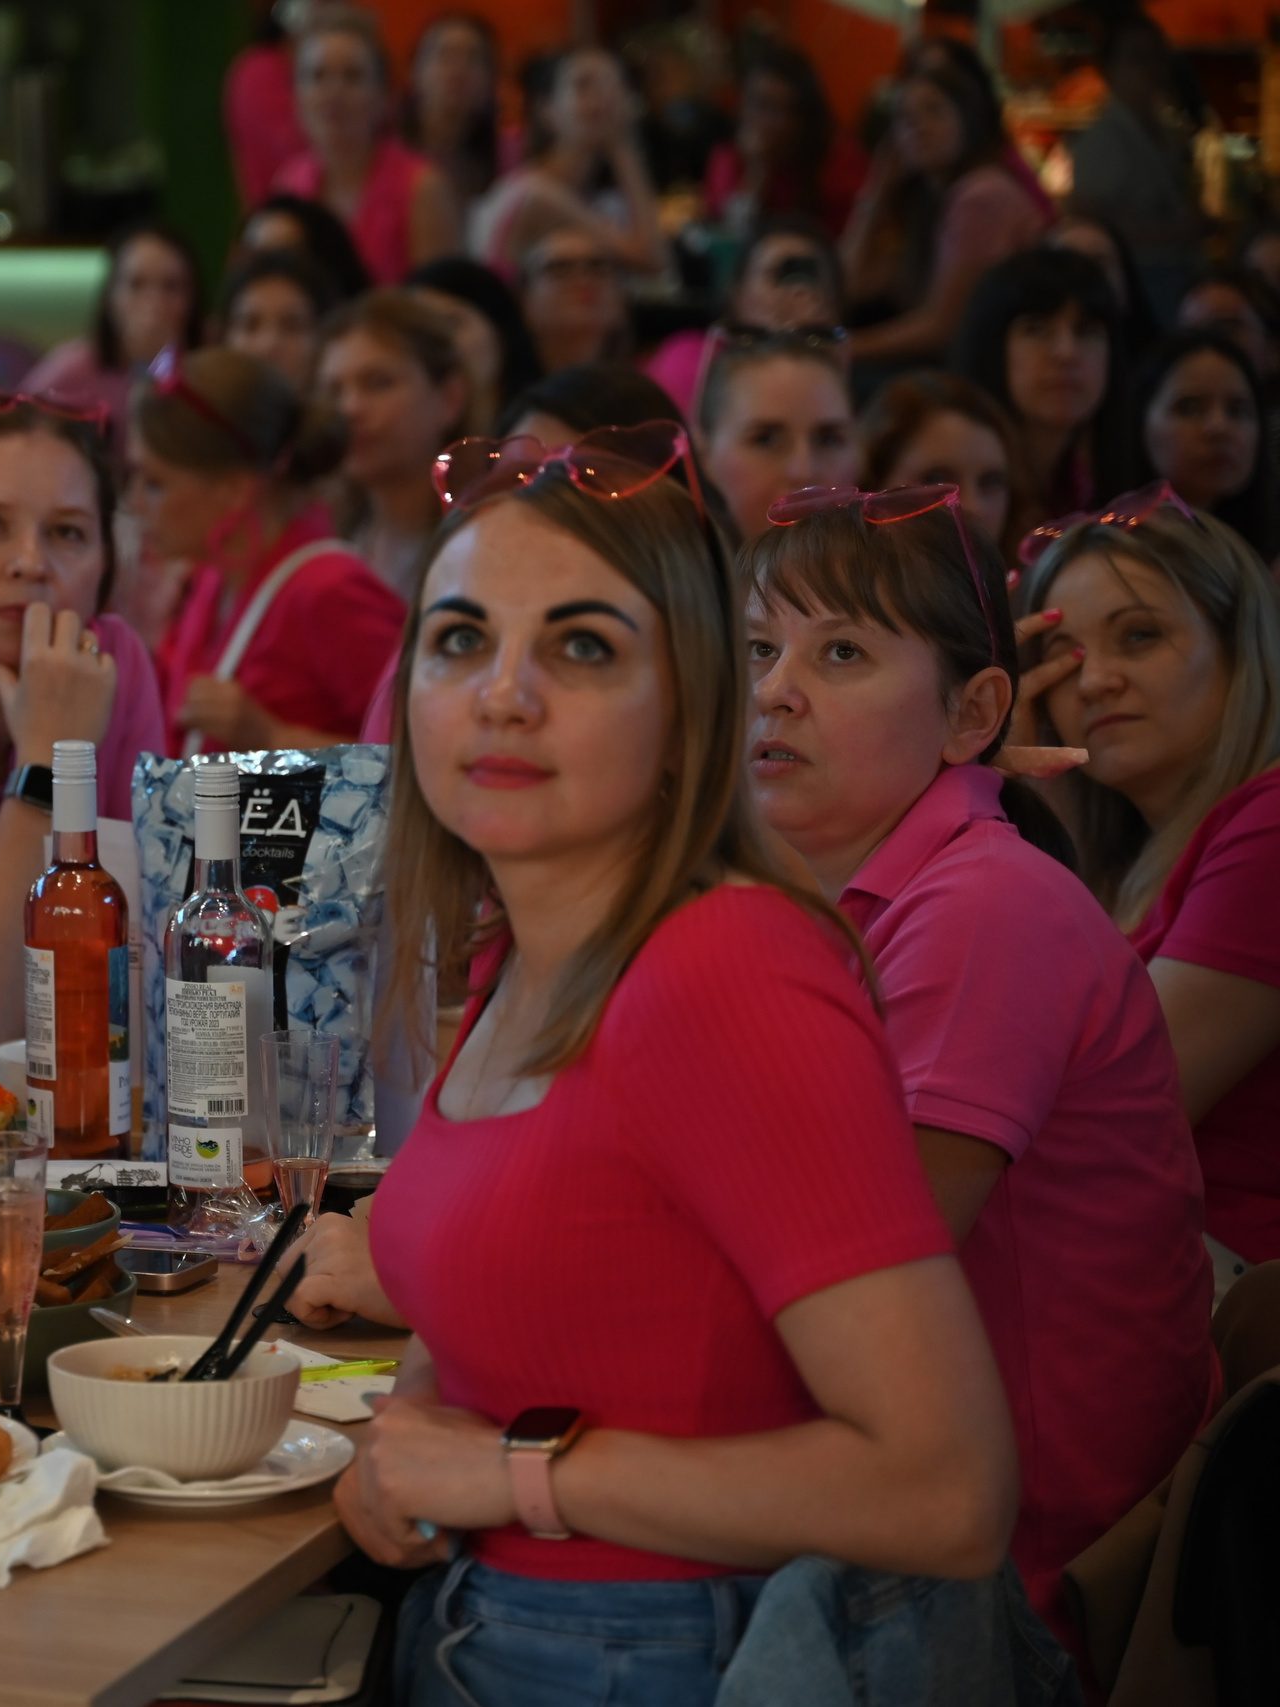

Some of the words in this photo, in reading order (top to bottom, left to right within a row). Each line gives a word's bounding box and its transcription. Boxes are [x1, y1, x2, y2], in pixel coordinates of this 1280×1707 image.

[240, 787, 307, 839] ЁД
[242, 847, 295, 859] cocktails
[209, 1010, 241, 1019] ПОРТУГАЛИЯ
[189, 1018, 208, 1027] УРОЖАЯ
[208, 1020, 220, 1028] 2023
[170, 1133, 191, 1146] VINHO
[171, 1142, 193, 1159] VERDE
